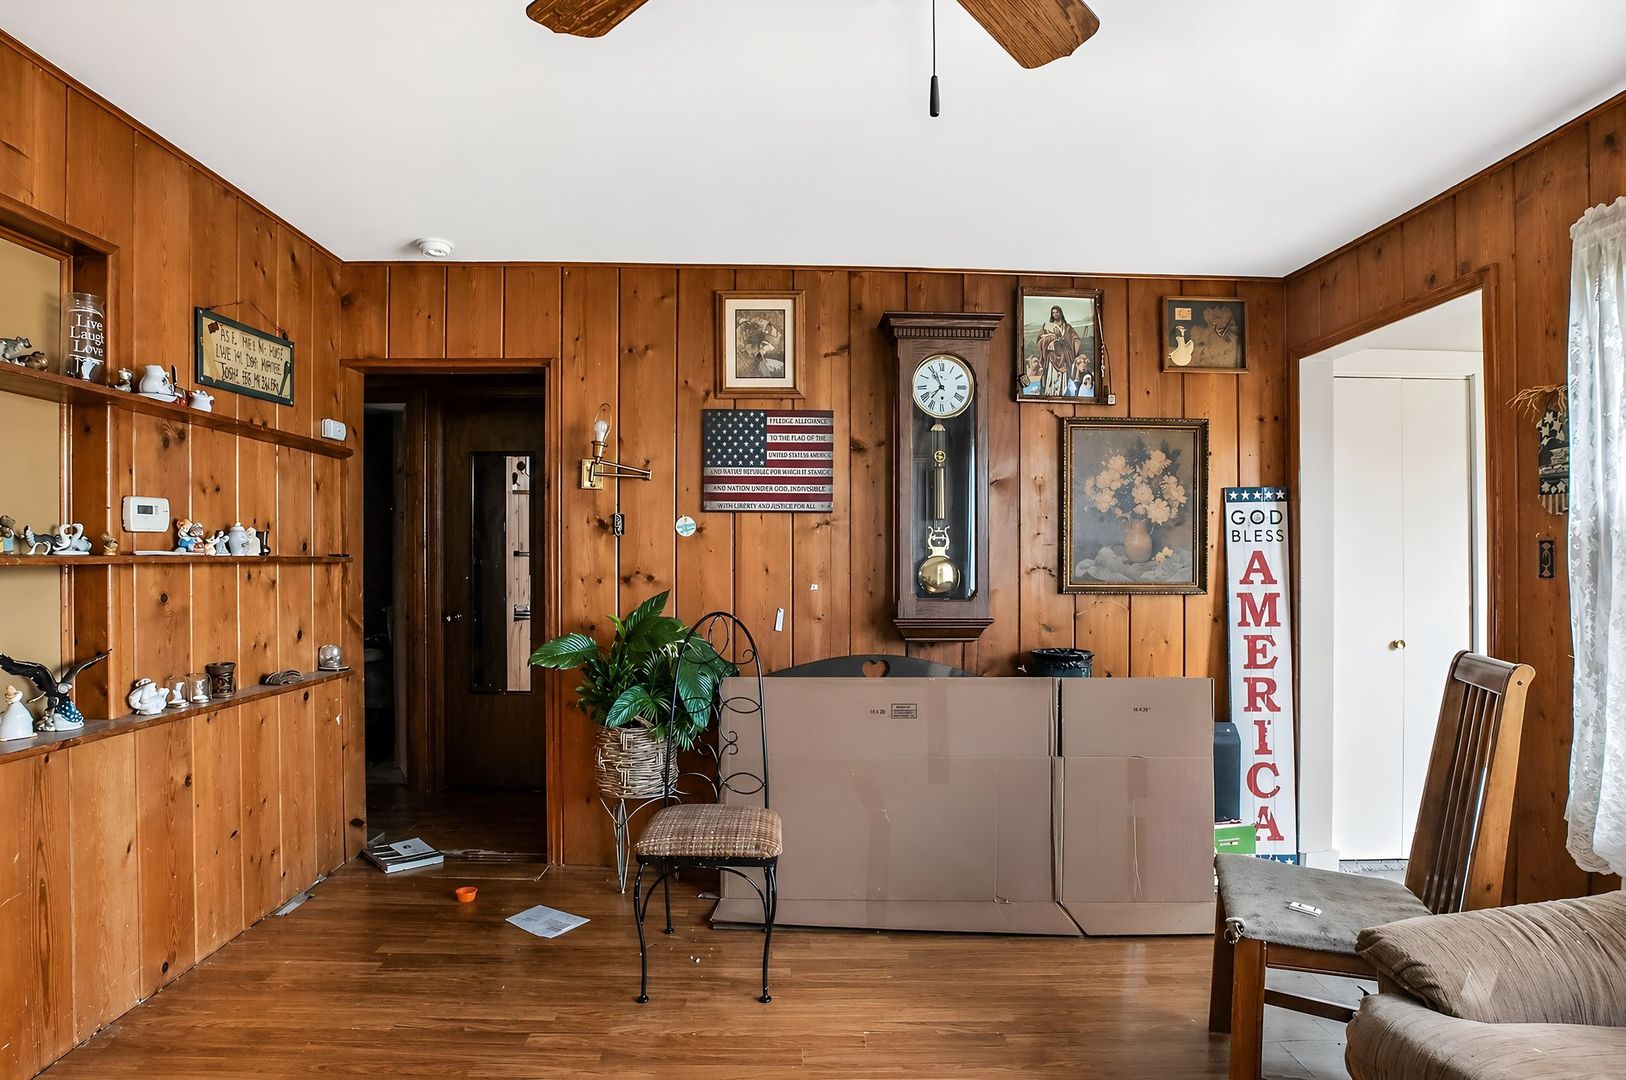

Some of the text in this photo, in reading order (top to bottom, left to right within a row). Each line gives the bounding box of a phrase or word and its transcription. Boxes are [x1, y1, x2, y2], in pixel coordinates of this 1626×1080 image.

[76, 313, 103, 331] Live
[73, 340, 103, 356] Love
[1231, 509, 1283, 525] GOD
[1231, 529, 1284, 543] BLESS
[1236, 550, 1284, 841] AMERICA
